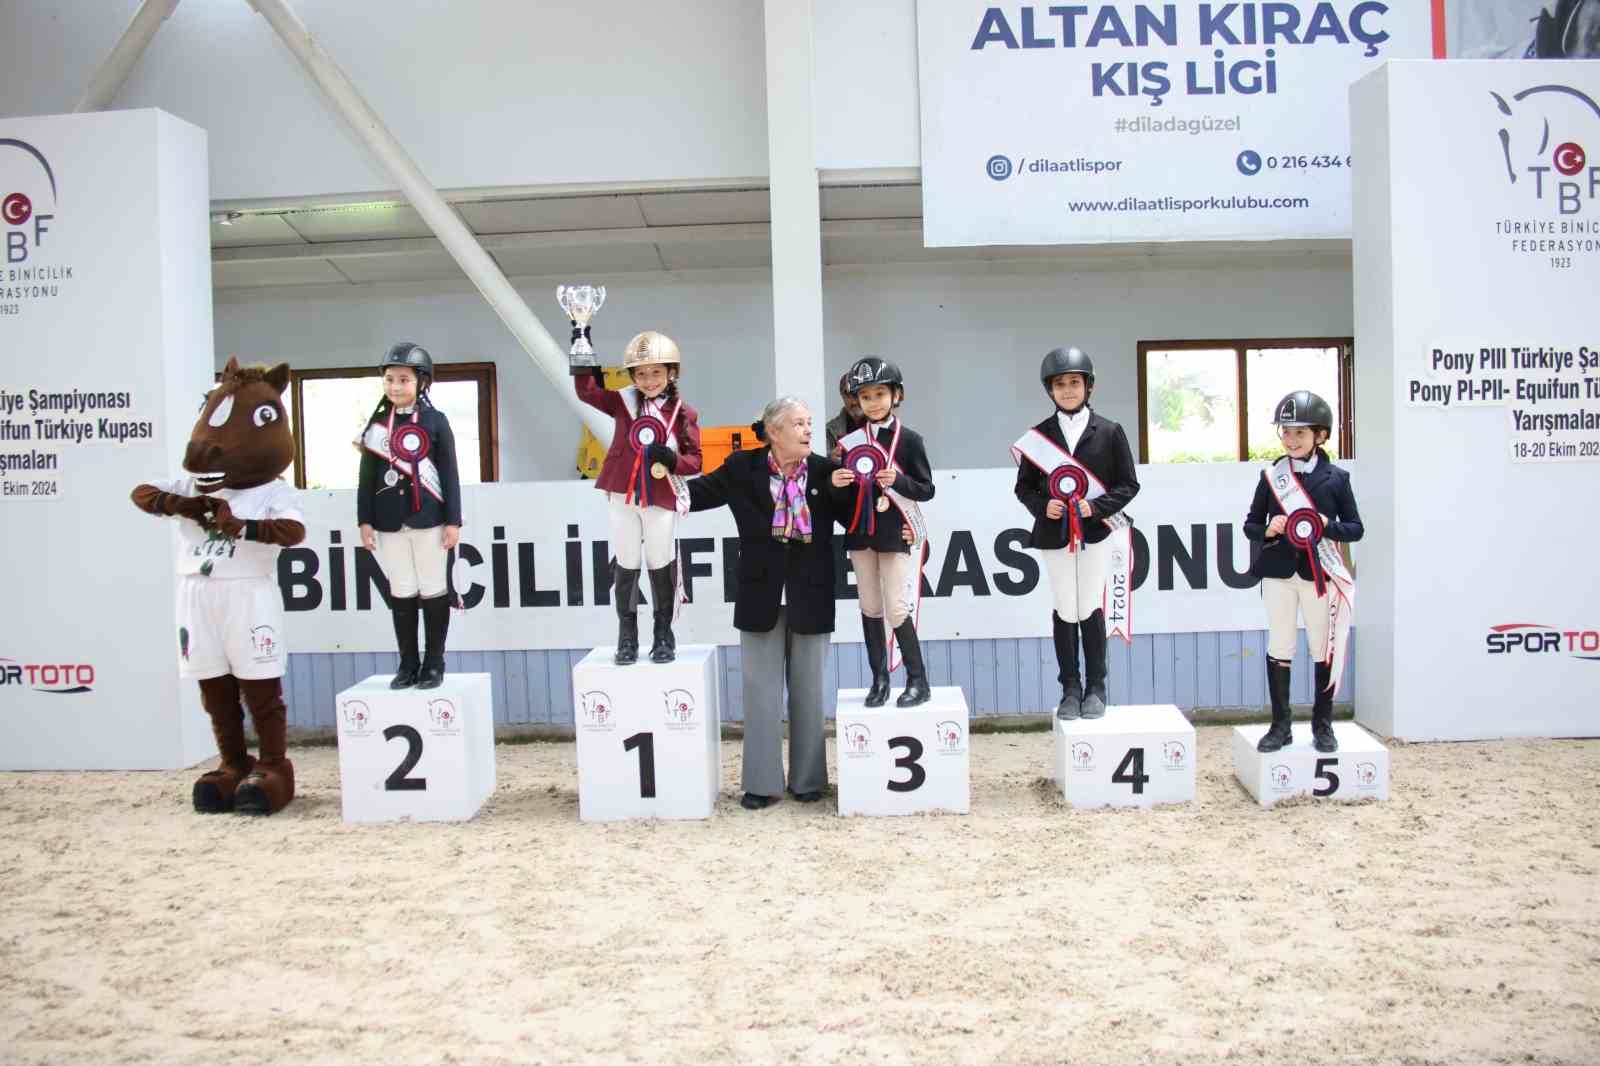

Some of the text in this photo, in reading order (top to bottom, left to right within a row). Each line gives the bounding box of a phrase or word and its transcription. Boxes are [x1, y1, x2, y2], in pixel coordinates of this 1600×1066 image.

[970, 1, 1390, 57] ALTAN KIRAÇ
[1091, 48, 1277, 106] KIŞ LİGİ
[1029, 159, 1123, 173] dilaatlispor
[1282, 156, 1308, 168] 216
[1311, 155, 1343, 168] 434
[1068, 196, 1309, 213] www.dilaatlisporkulubu.com
[1496, 218, 1555, 234] TÜRKİYE
[9, 266, 73, 281] BİNİCİLİK
[1551, 257, 1571, 269] 1923
[1432, 349, 1474, 374] Pony
[1511, 347, 1573, 373] Türkiye
[29, 388, 130, 416] Şampiyonası
[1410, 380, 1452, 406] Pony
[1516, 378, 1580, 404] Equifun
[34, 418, 93, 443] Türkiye
[98, 418, 153, 443] Kupası
[1513, 442, 1546, 458] 18-20
[1549, 441, 1576, 457] Ekim
[3, 480, 57, 496] Ekim 2024
[1109, 574, 1126, 623] 2024
[383, 724, 427, 792] 2
[623, 732, 656, 798] 1
[886, 736, 926, 793] 3
[1111, 747, 1150, 794] 4
[1312, 757, 1341, 797] 5
